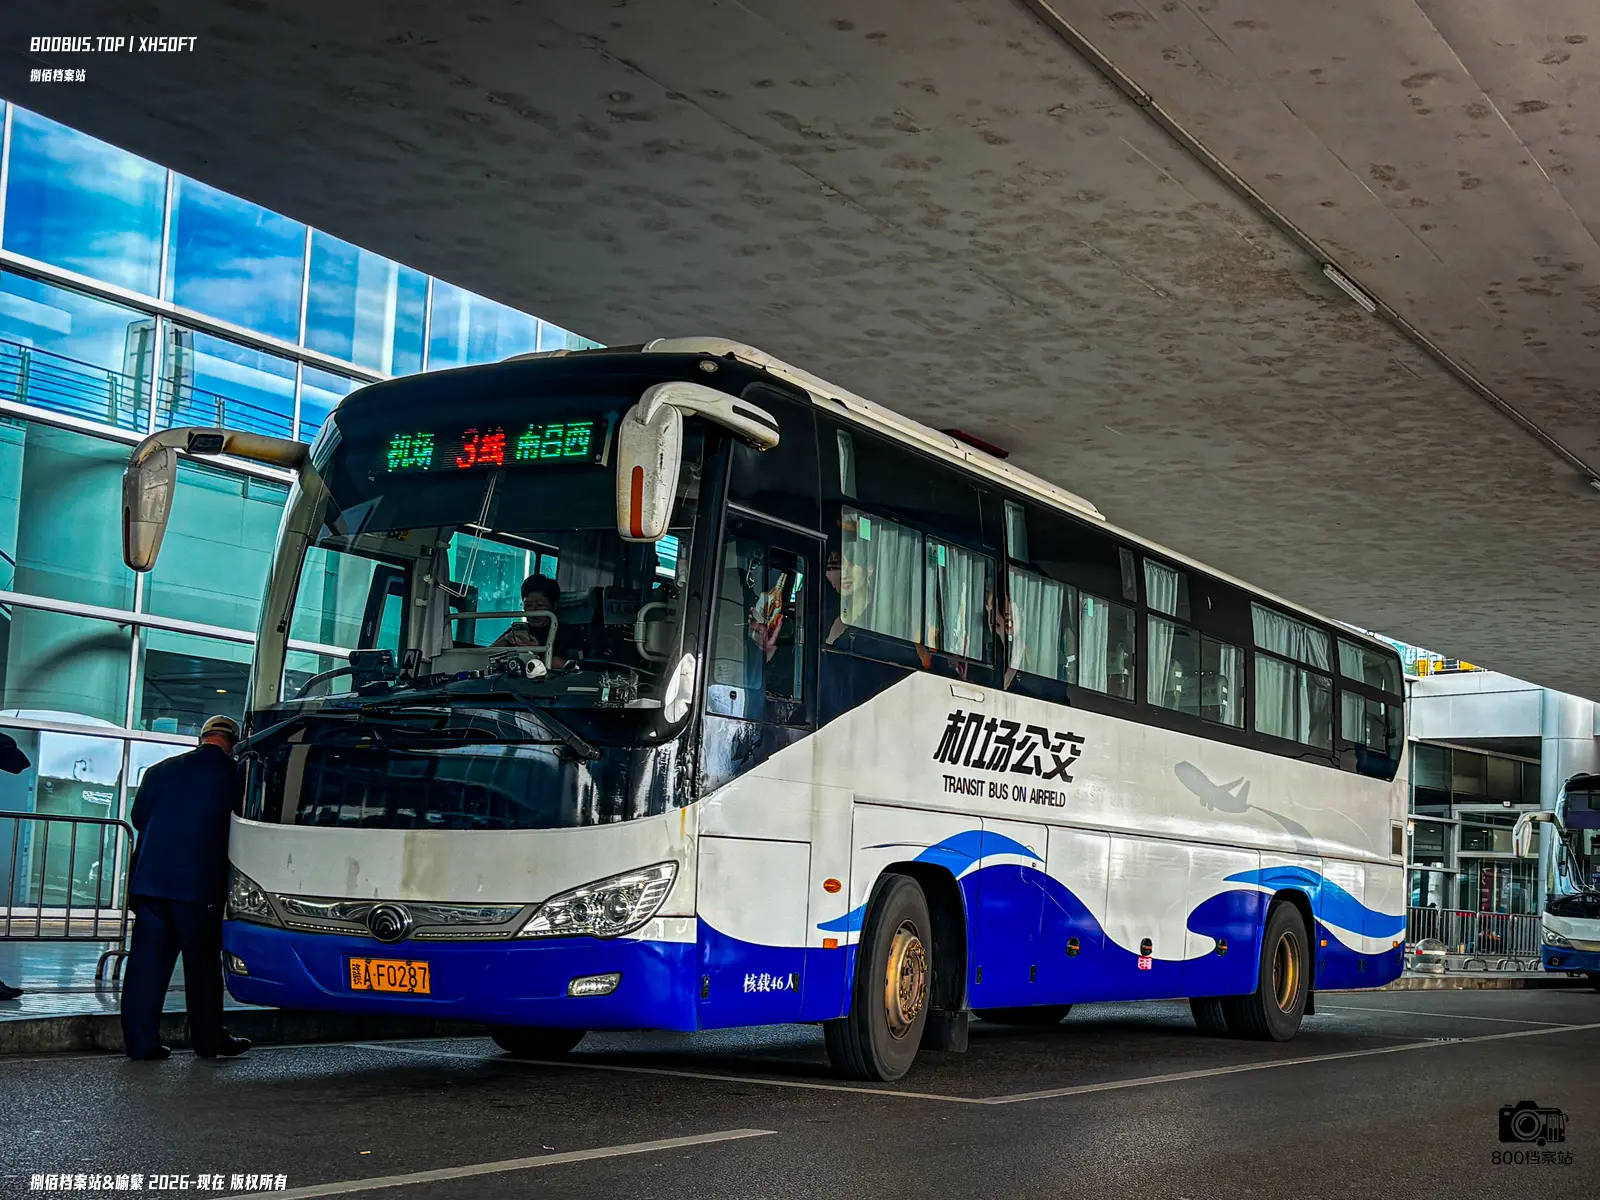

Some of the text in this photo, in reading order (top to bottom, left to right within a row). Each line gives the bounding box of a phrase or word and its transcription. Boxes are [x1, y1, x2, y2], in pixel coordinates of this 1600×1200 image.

[933, 709, 1086, 784] 机场公交
[942, 774, 1066, 808] TRANSIT BUS ON AIRFIELD
[743, 972, 796, 993] 核载46人
